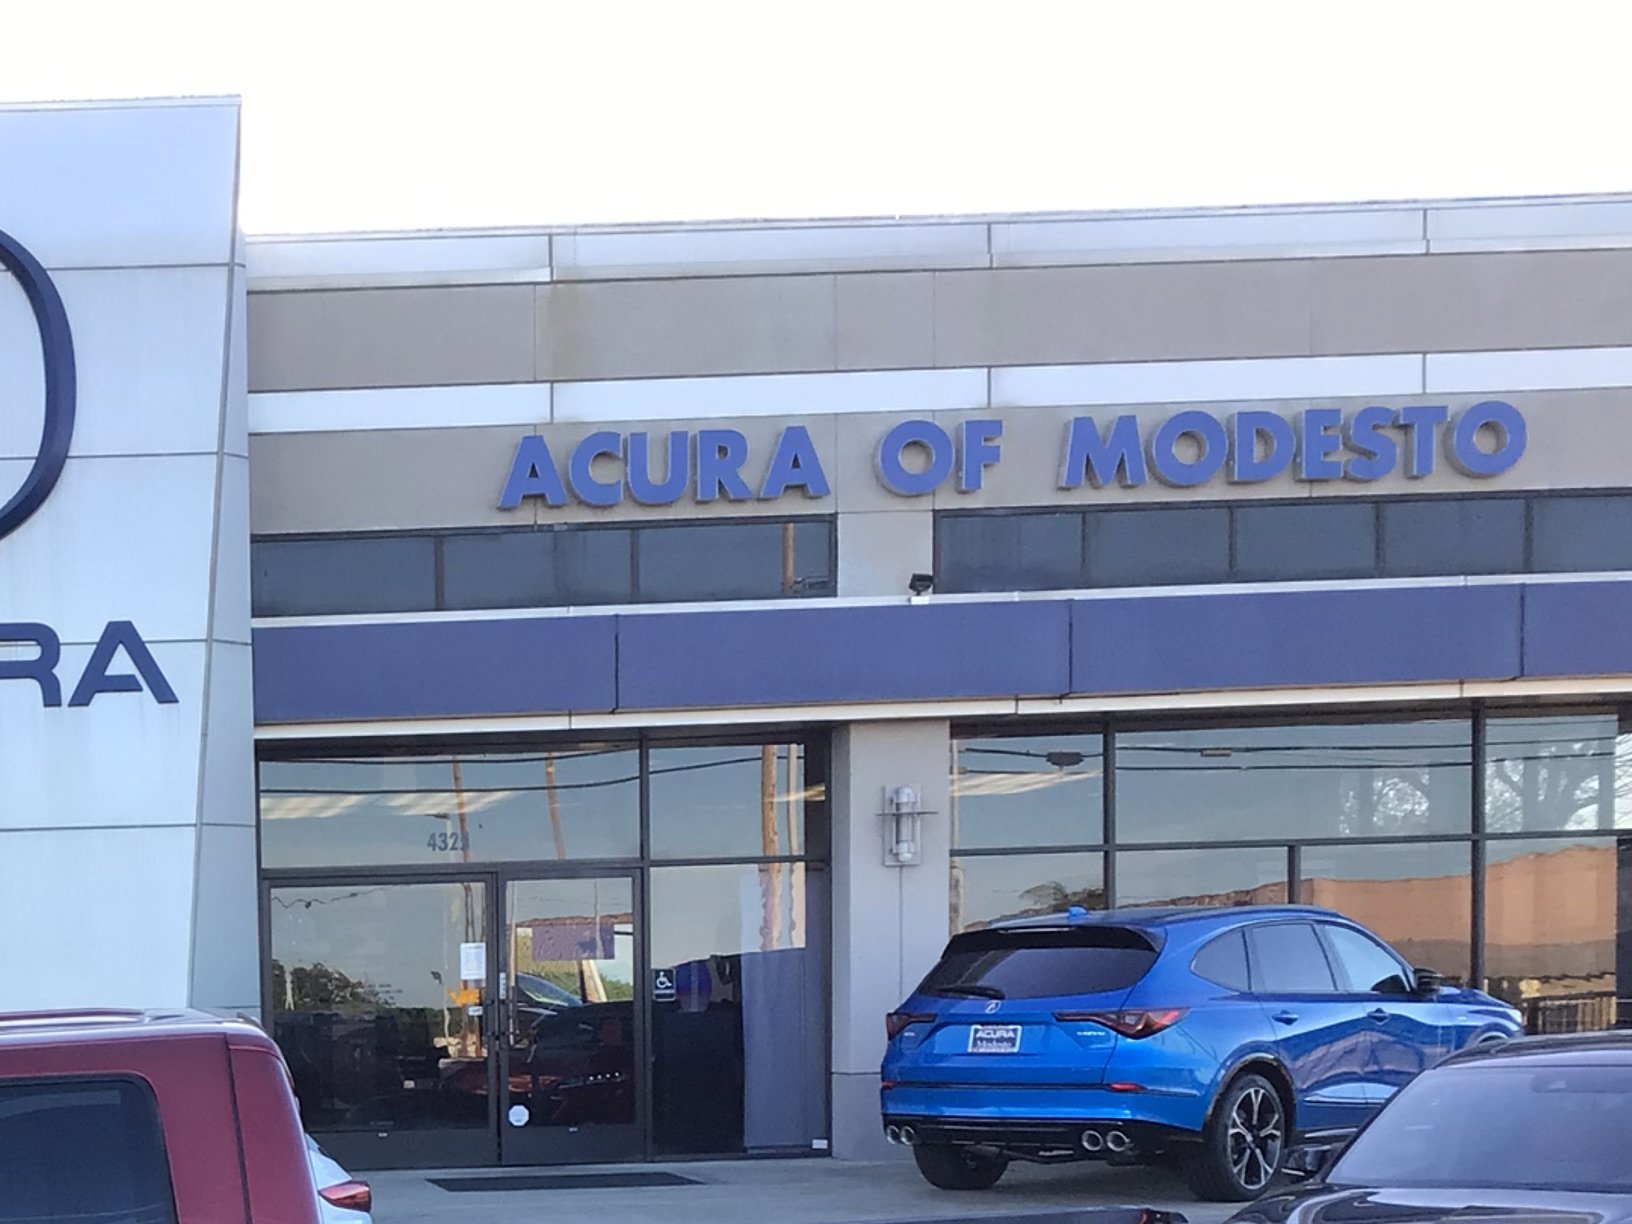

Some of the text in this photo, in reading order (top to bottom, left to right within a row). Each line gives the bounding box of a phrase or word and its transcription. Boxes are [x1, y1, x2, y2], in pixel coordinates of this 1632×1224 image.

[498, 398, 1528, 511] ACURA OF MODESTO
[976, 1029, 1015, 1038] ACURA
